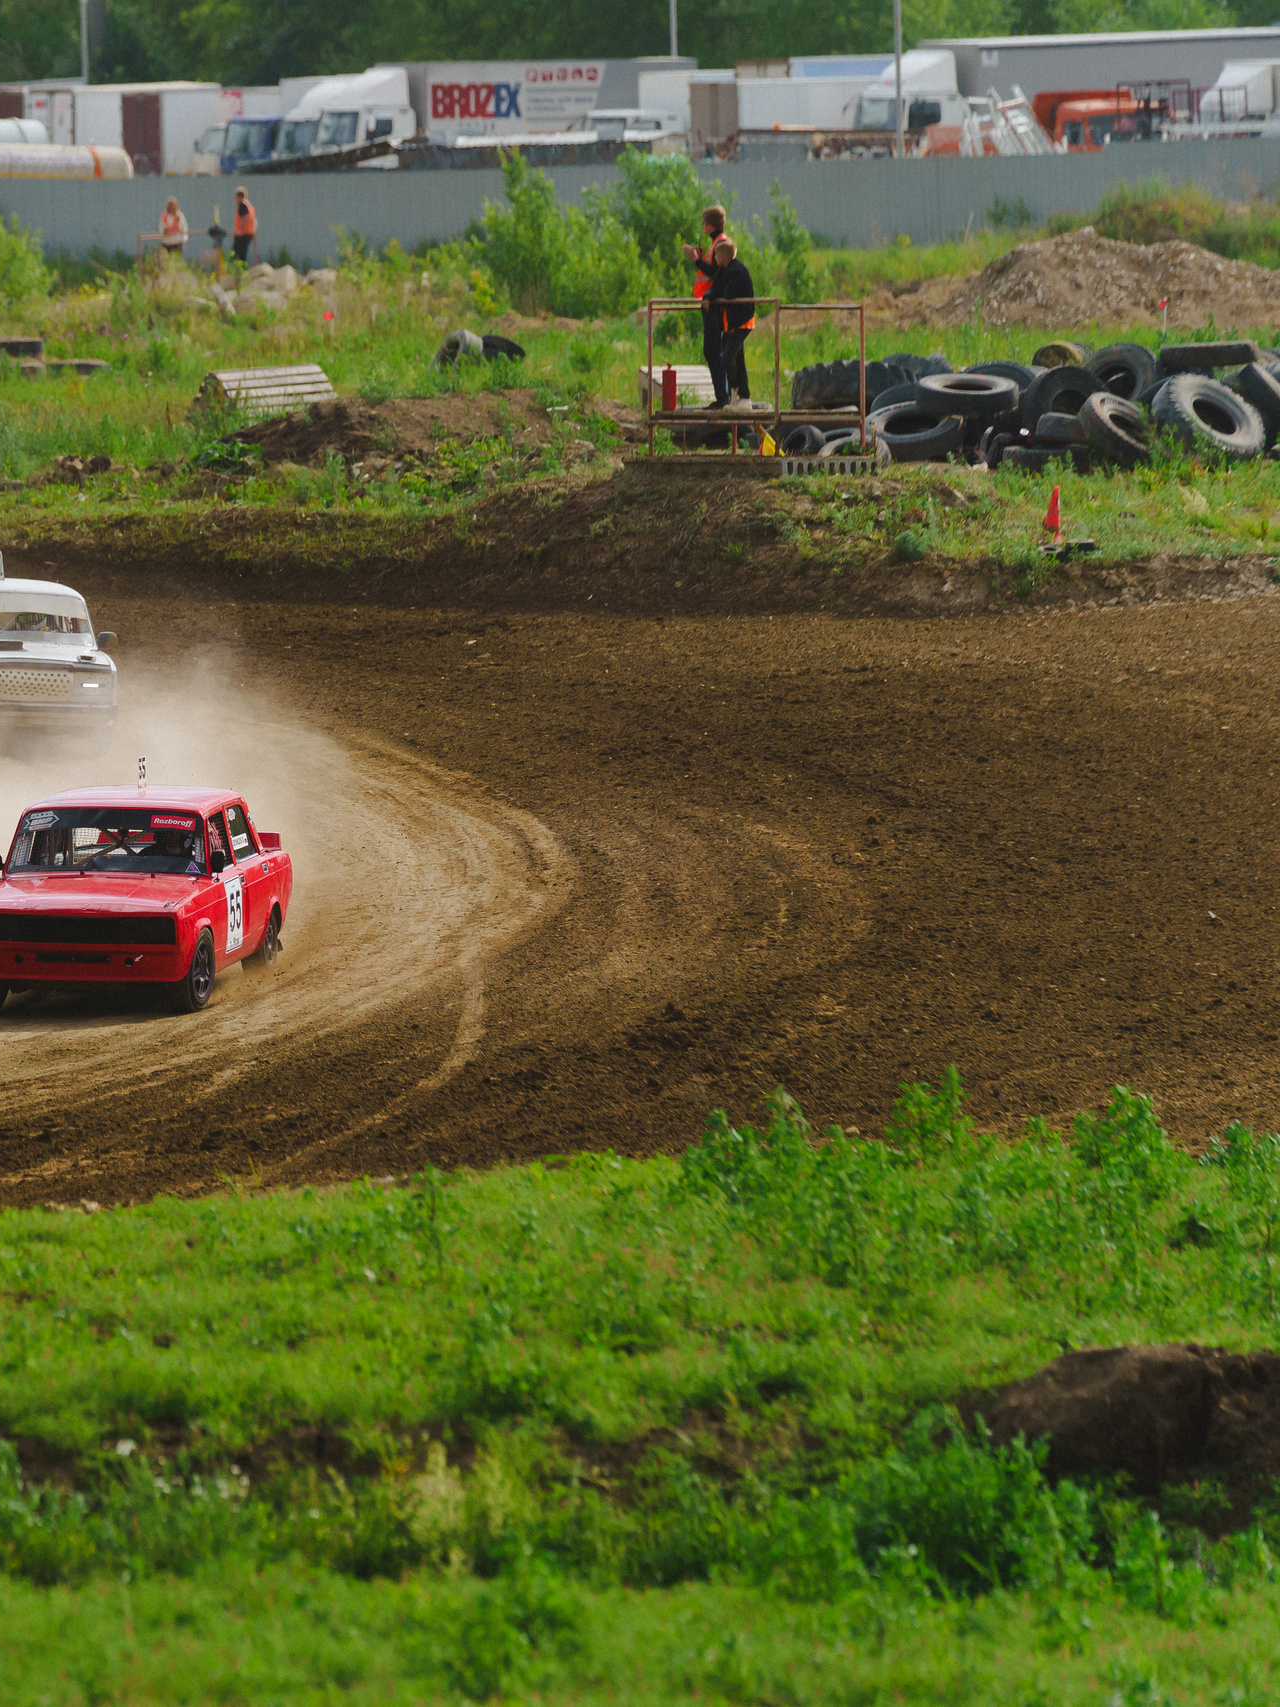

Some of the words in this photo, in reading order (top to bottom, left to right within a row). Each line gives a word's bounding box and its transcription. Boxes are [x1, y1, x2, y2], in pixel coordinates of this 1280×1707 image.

[431, 83, 521, 119] BROZEX
[139, 756, 146, 780] 55
[153, 817, 194, 828] Razboroff
[229, 889, 242, 933] 55
